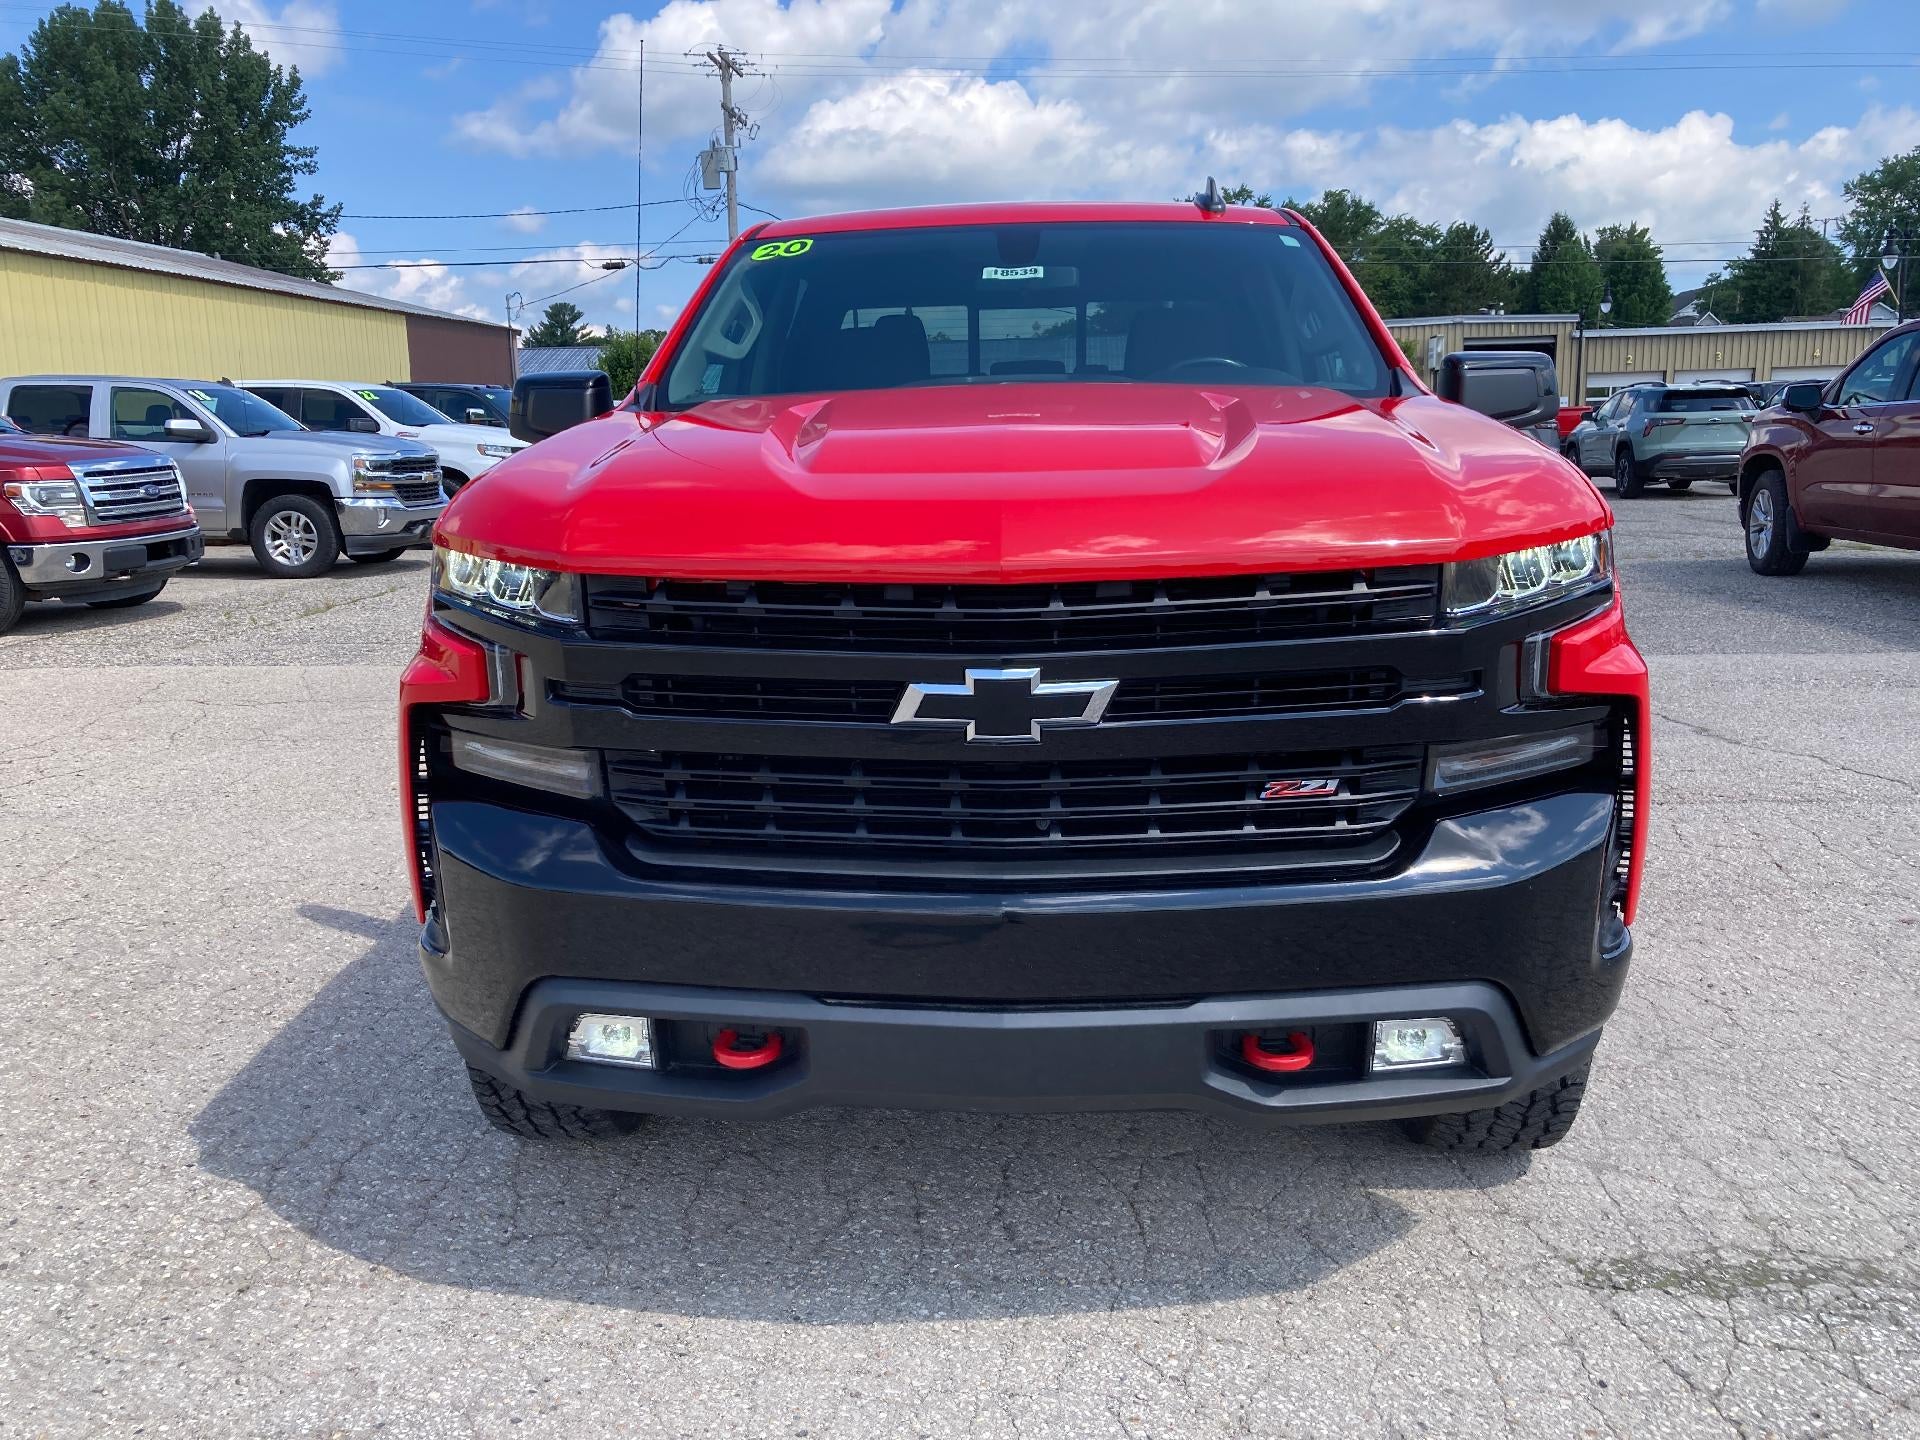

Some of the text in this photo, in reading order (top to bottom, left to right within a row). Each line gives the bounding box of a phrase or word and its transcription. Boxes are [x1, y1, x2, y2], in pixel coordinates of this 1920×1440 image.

[753, 240, 811, 259] 20
[993, 267, 1038, 277] 18539
[1715, 351, 1722, 361] 3
[1813, 348, 1821, 358] 4
[1626, 354, 1633, 364] 2
[1260, 779, 1340, 799] Z71
